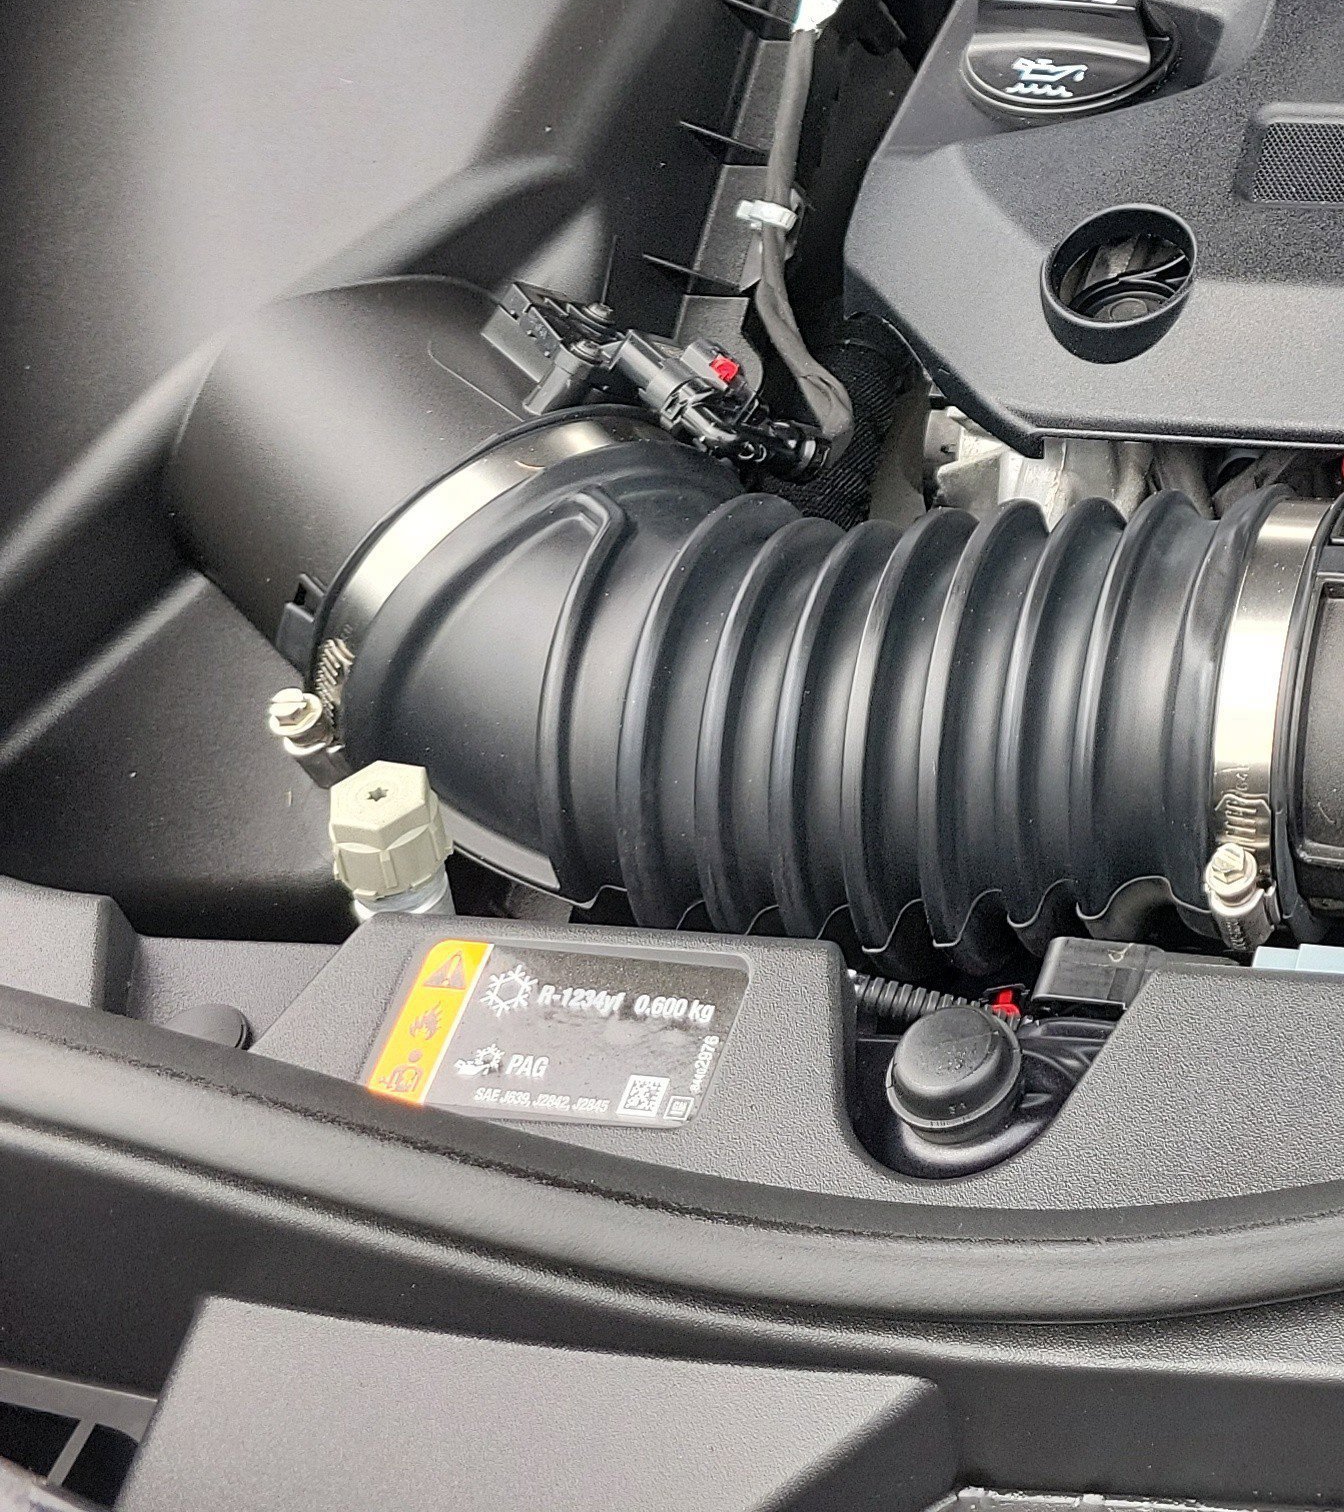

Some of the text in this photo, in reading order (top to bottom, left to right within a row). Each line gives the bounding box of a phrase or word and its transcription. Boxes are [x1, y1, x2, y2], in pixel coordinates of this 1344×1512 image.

[538, 984, 716, 1025] R-1234yf 0.600 kg
[506, 1054, 550, 1078] PAG
[474, 1087, 611, 1114] SAE J639, J2842, J2845
